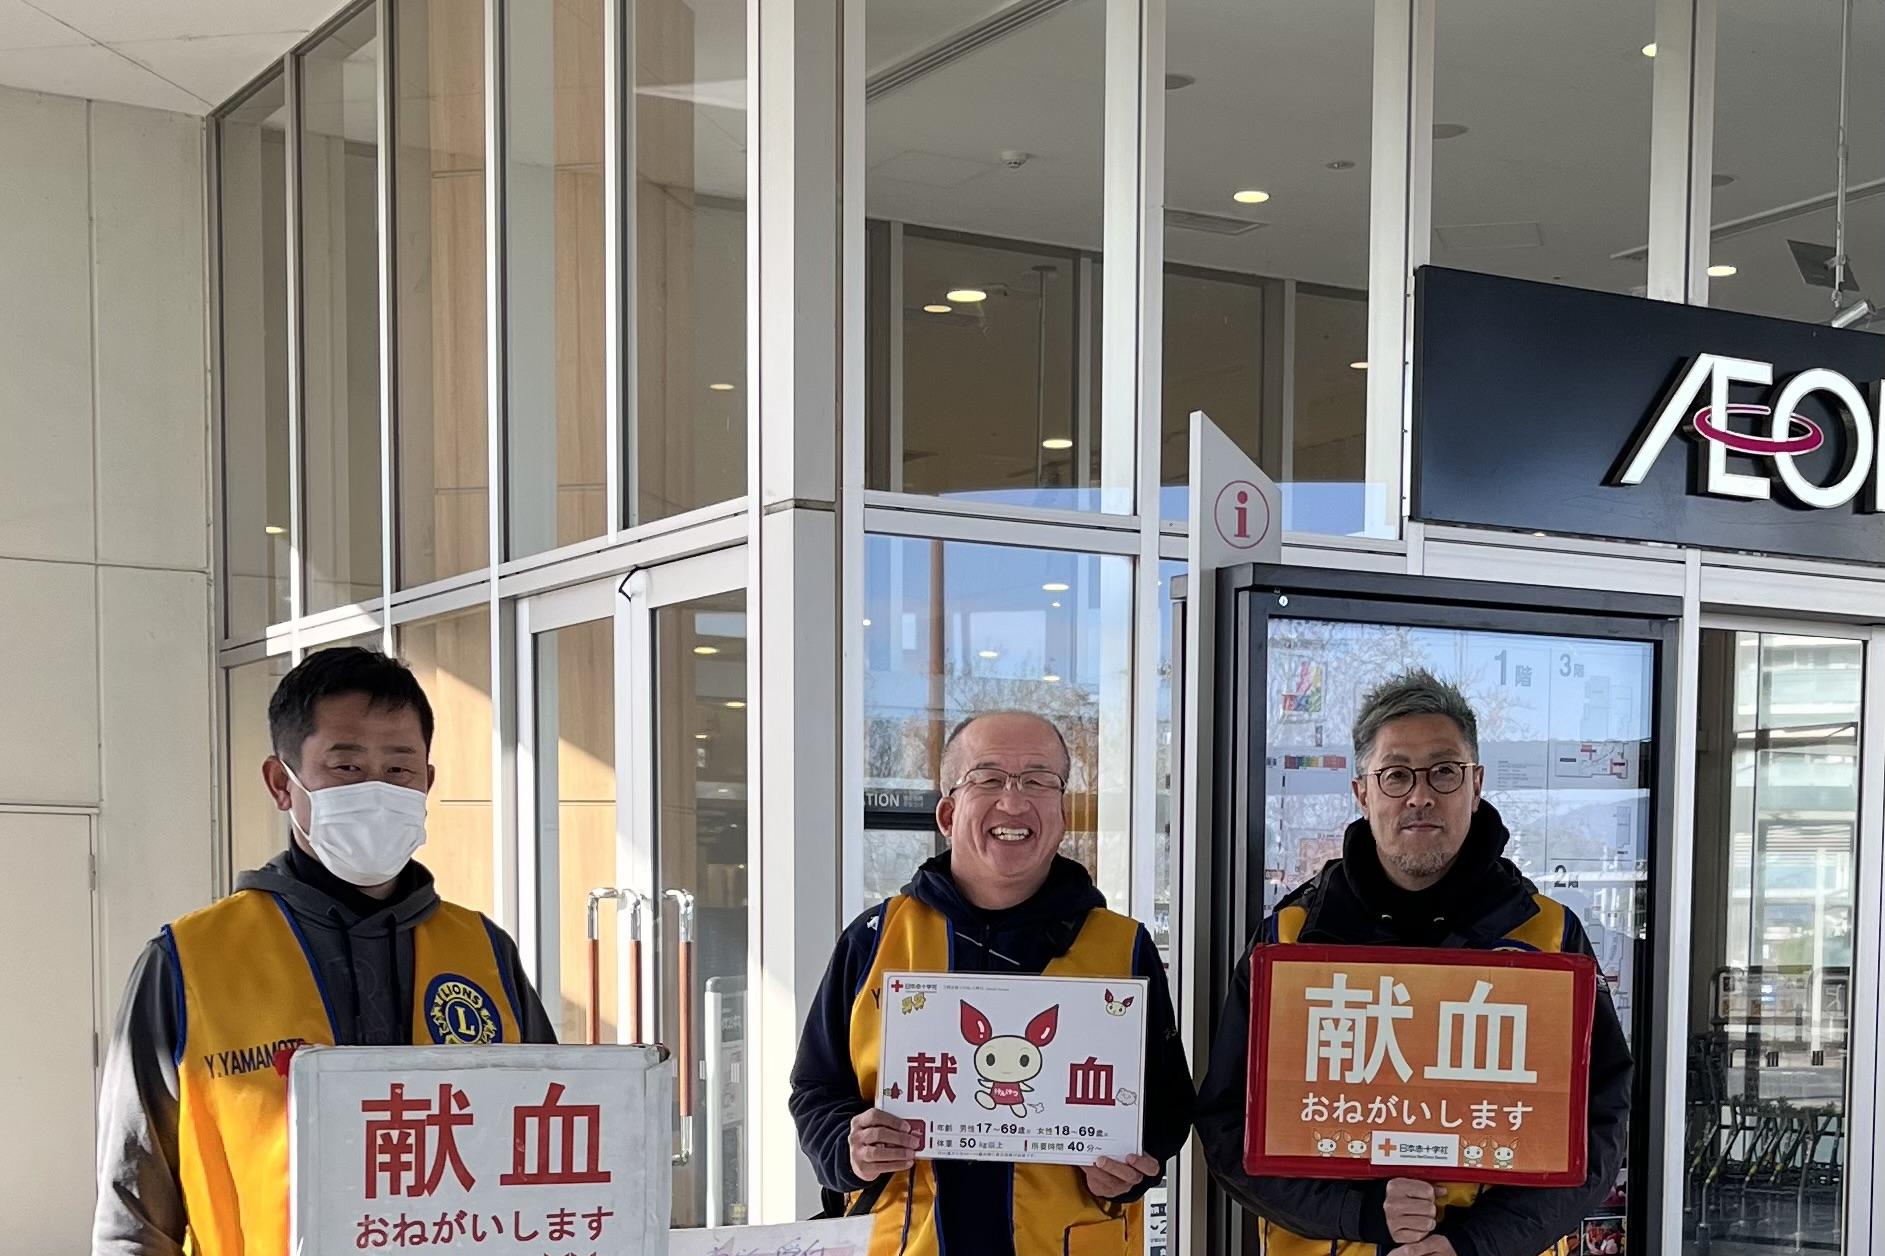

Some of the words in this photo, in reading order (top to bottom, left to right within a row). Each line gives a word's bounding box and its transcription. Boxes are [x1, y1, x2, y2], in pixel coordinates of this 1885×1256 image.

[1621, 353, 1885, 512] AEO
[1495, 649, 1532, 687] 1階
[1559, 653, 1584, 678] 3階
[864, 792, 900, 807] TION
[439, 984, 481, 1006] LIONS
[454, 1005, 476, 1036] L
[1305, 972, 1538, 1084] 献血
[204, 1038, 305, 1080] Y.YAMAM
[1300, 1092, 1534, 1131] おねがいします
[361, 1082, 612, 1199] 献血
[356, 1206, 614, 1249] おねがいします
